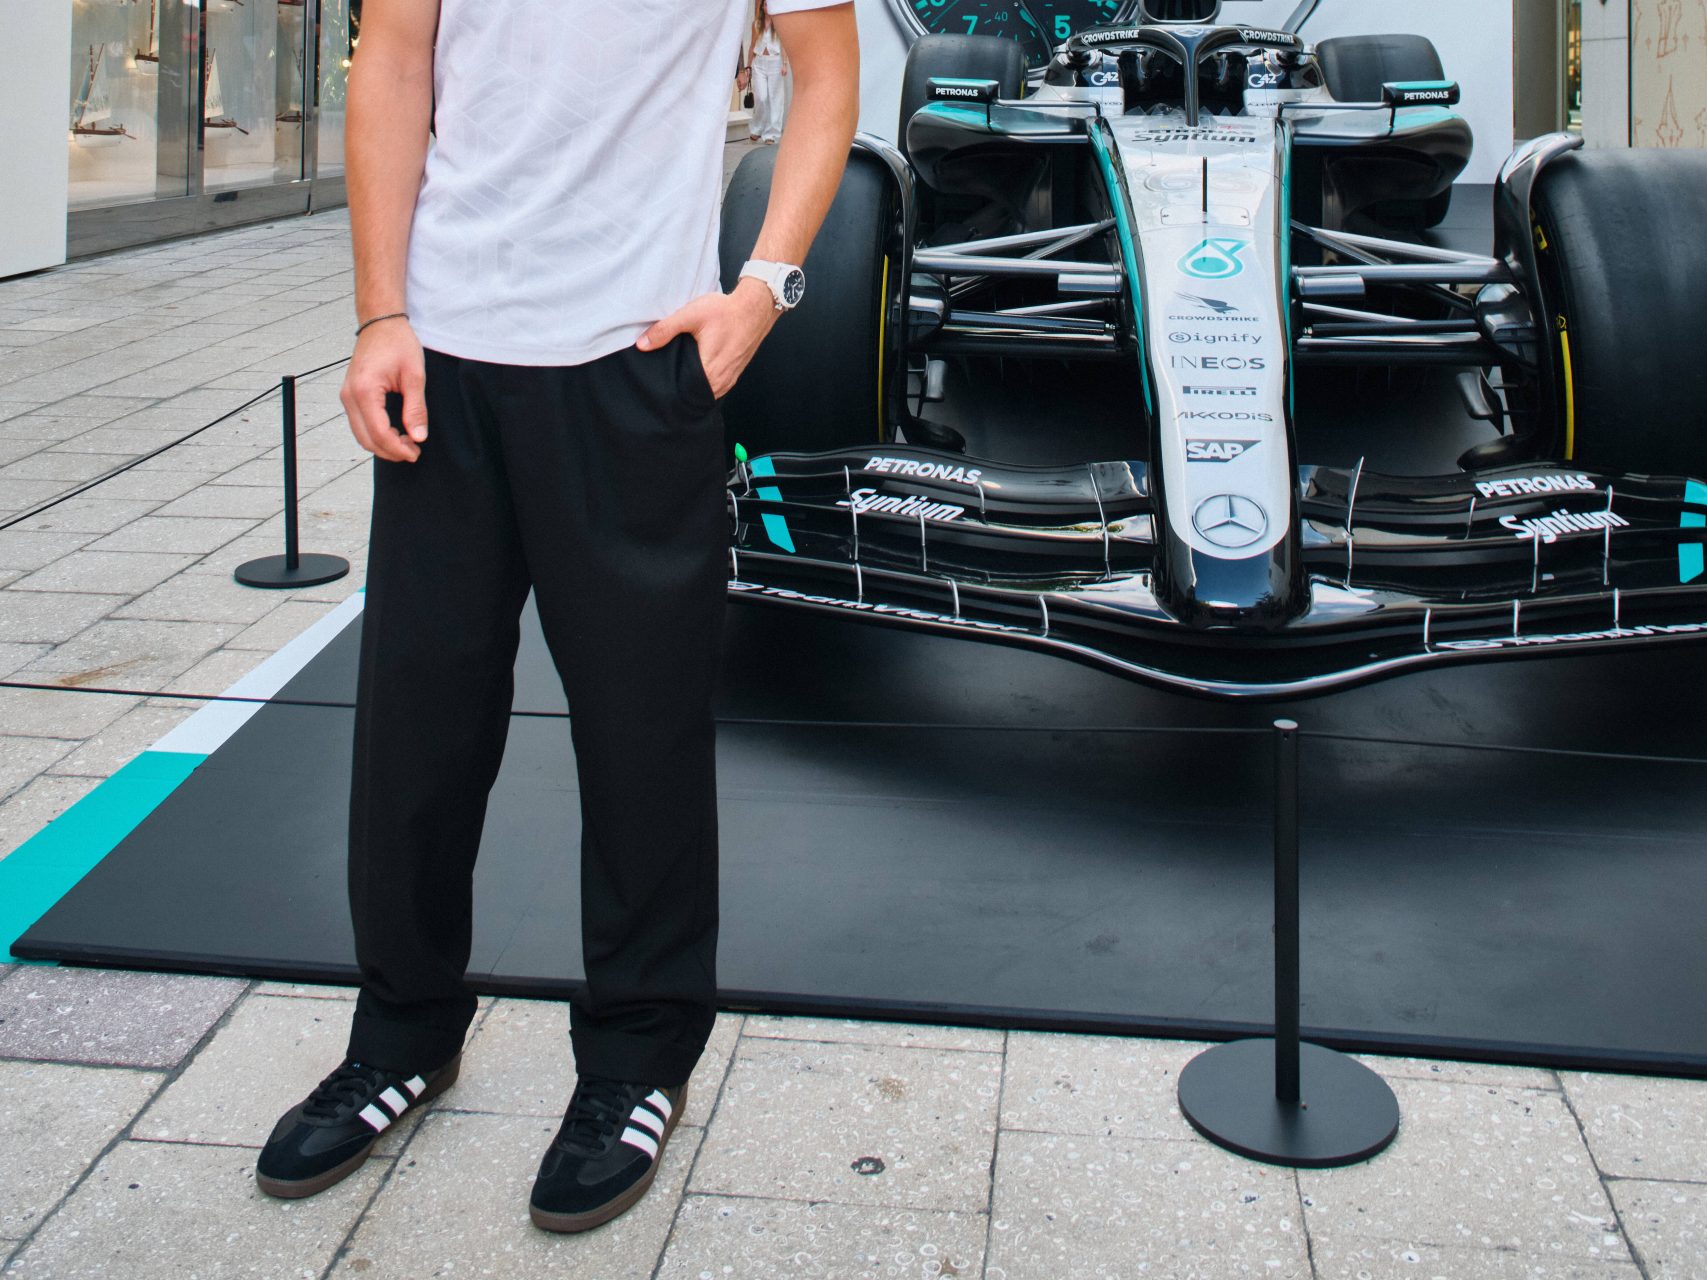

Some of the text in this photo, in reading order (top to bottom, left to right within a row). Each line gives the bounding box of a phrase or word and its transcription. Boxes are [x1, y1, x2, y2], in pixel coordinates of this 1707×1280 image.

[962, 15, 978, 36] 7
[1054, 15, 1071, 39] 5
[1083, 30, 1140, 44] CROWDSTRIKE
[1243, 30, 1295, 44] CROWDSTRIKE
[1091, 71, 1119, 86] G42
[1248, 73, 1277, 88] G42
[935, 87, 979, 97] PETRONAS
[1404, 91, 1449, 100] PETRONAS
[1171, 355, 1265, 370] INEOS
[1182, 385, 1257, 396] PIRELLI
[1187, 441, 1244, 460] SAP
[863, 456, 982, 485] PETRONAS
[1475, 475, 1596, 498] PETRONAS
[835, 487, 965, 521] Syntium
[1498, 508, 1630, 544] Syntium
